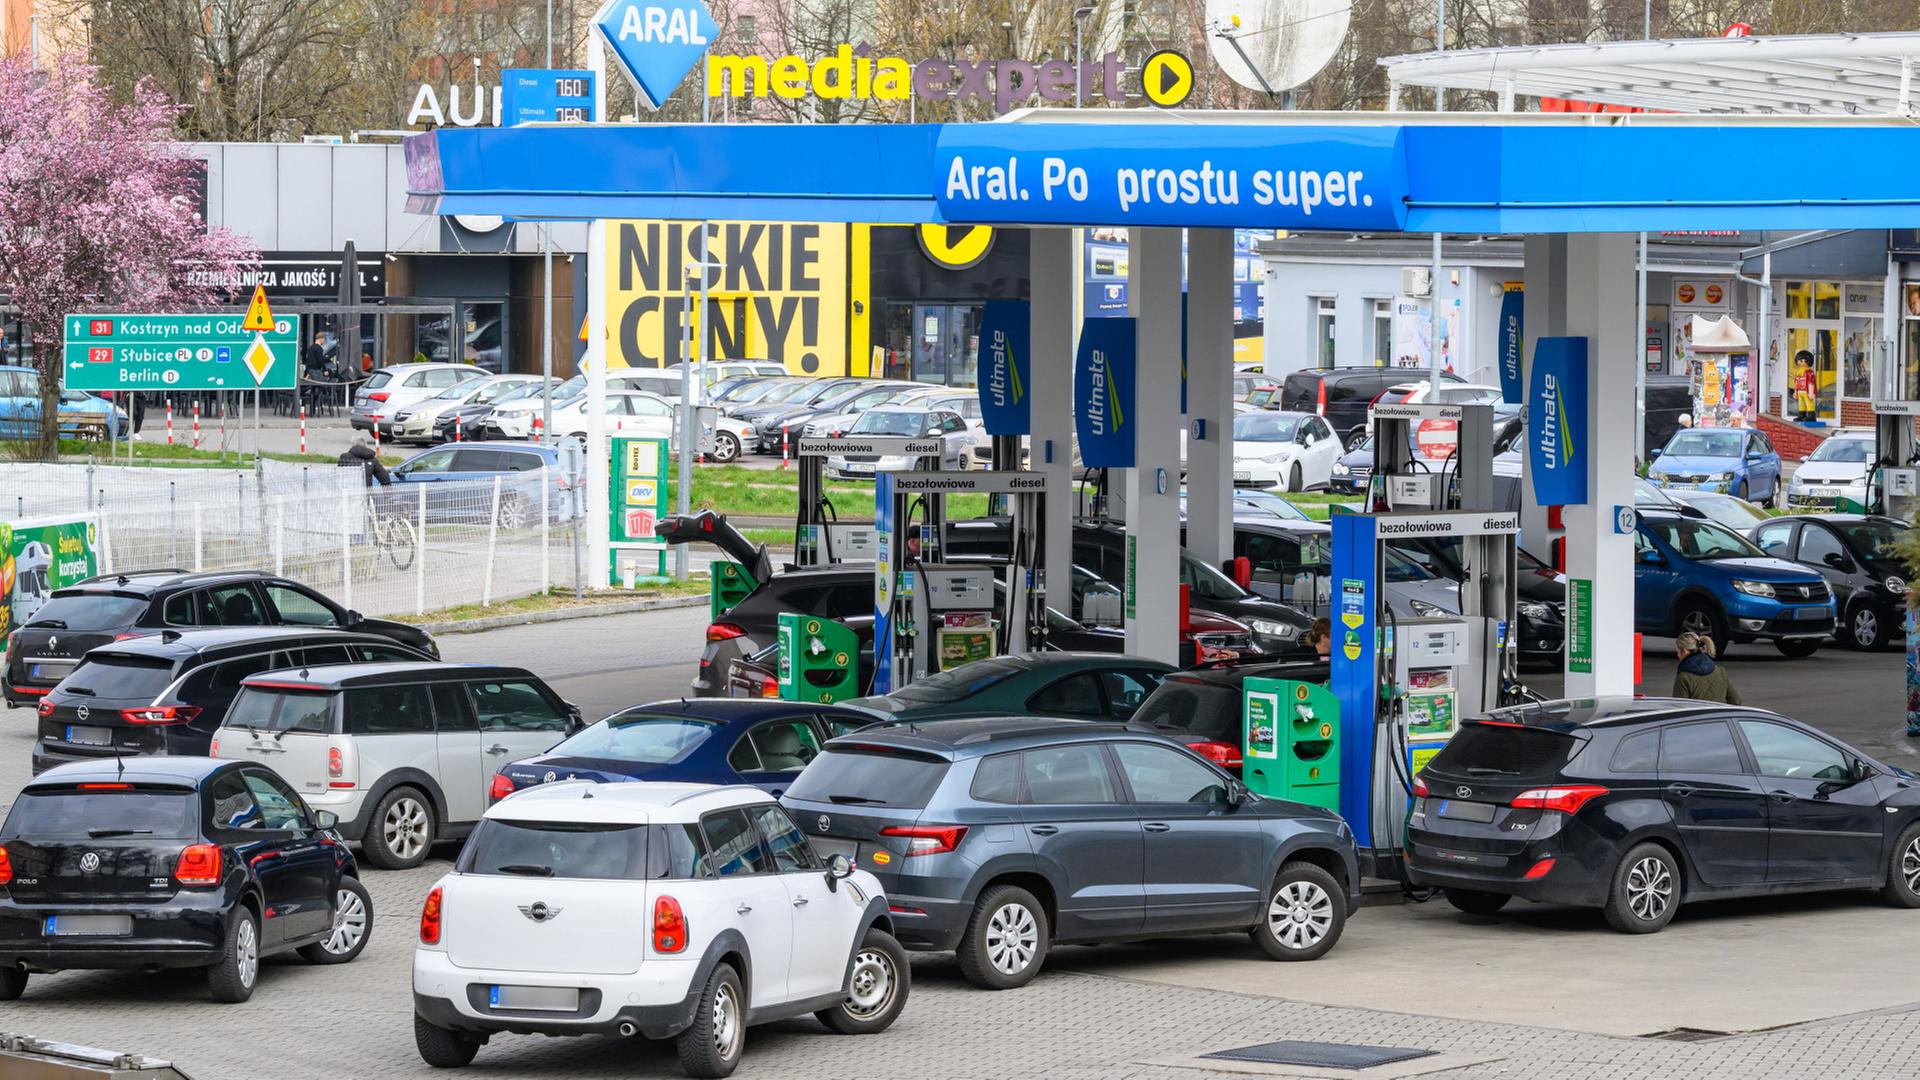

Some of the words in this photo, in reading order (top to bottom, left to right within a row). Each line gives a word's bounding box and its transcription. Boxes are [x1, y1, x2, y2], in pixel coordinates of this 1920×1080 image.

[618, 5, 707, 45] ARAL
[519, 78, 538, 87] Diesel
[519, 108, 545, 116] Ultimate
[946, 156, 1029, 201] Aral.
[1042, 157, 1089, 201] Po
[1117, 161, 1240, 211] prostu
[1252, 167, 1374, 216] super.
[619, 223, 820, 292] NISKIE
[281, 268, 326, 287] JAKOŚĆ
[95, 322, 108, 333] 31
[120, 321, 180, 340] Kostrzyn
[184, 322, 211, 335] nad
[279, 323, 286, 332] D
[619, 295, 820, 374] CENY!
[94, 350, 108, 360] 29
[120, 349, 173, 363] Słubice
[177, 350, 189, 360] PL
[201, 350, 208, 360] D
[1506, 315, 1517, 380] ultimate
[119, 369, 160, 382] Berlin
[167, 372, 174, 382] D
[989, 330, 1005, 407] ultimate
[1087, 350, 1104, 436] ultimate
[1374, 407, 1421, 417] bezołowiowa
[1439, 407, 1461, 417] diesel
[1538, 373, 1557, 470] ultimate
[800, 442, 873, 453] bezołowiowa
[905, 443, 938, 453] diesel
[631, 488, 653, 497] DKV
[897, 478, 975, 489] bezołowiowa
[1009, 478, 1045, 489] diesel
[630, 511, 653, 534] UTA
[1380, 521, 1452, 533] bezołowiowa
[1483, 518, 1516, 530] diesel
[1620, 513, 1633, 528] 12
[58, 555, 88, 580] korzystaj
